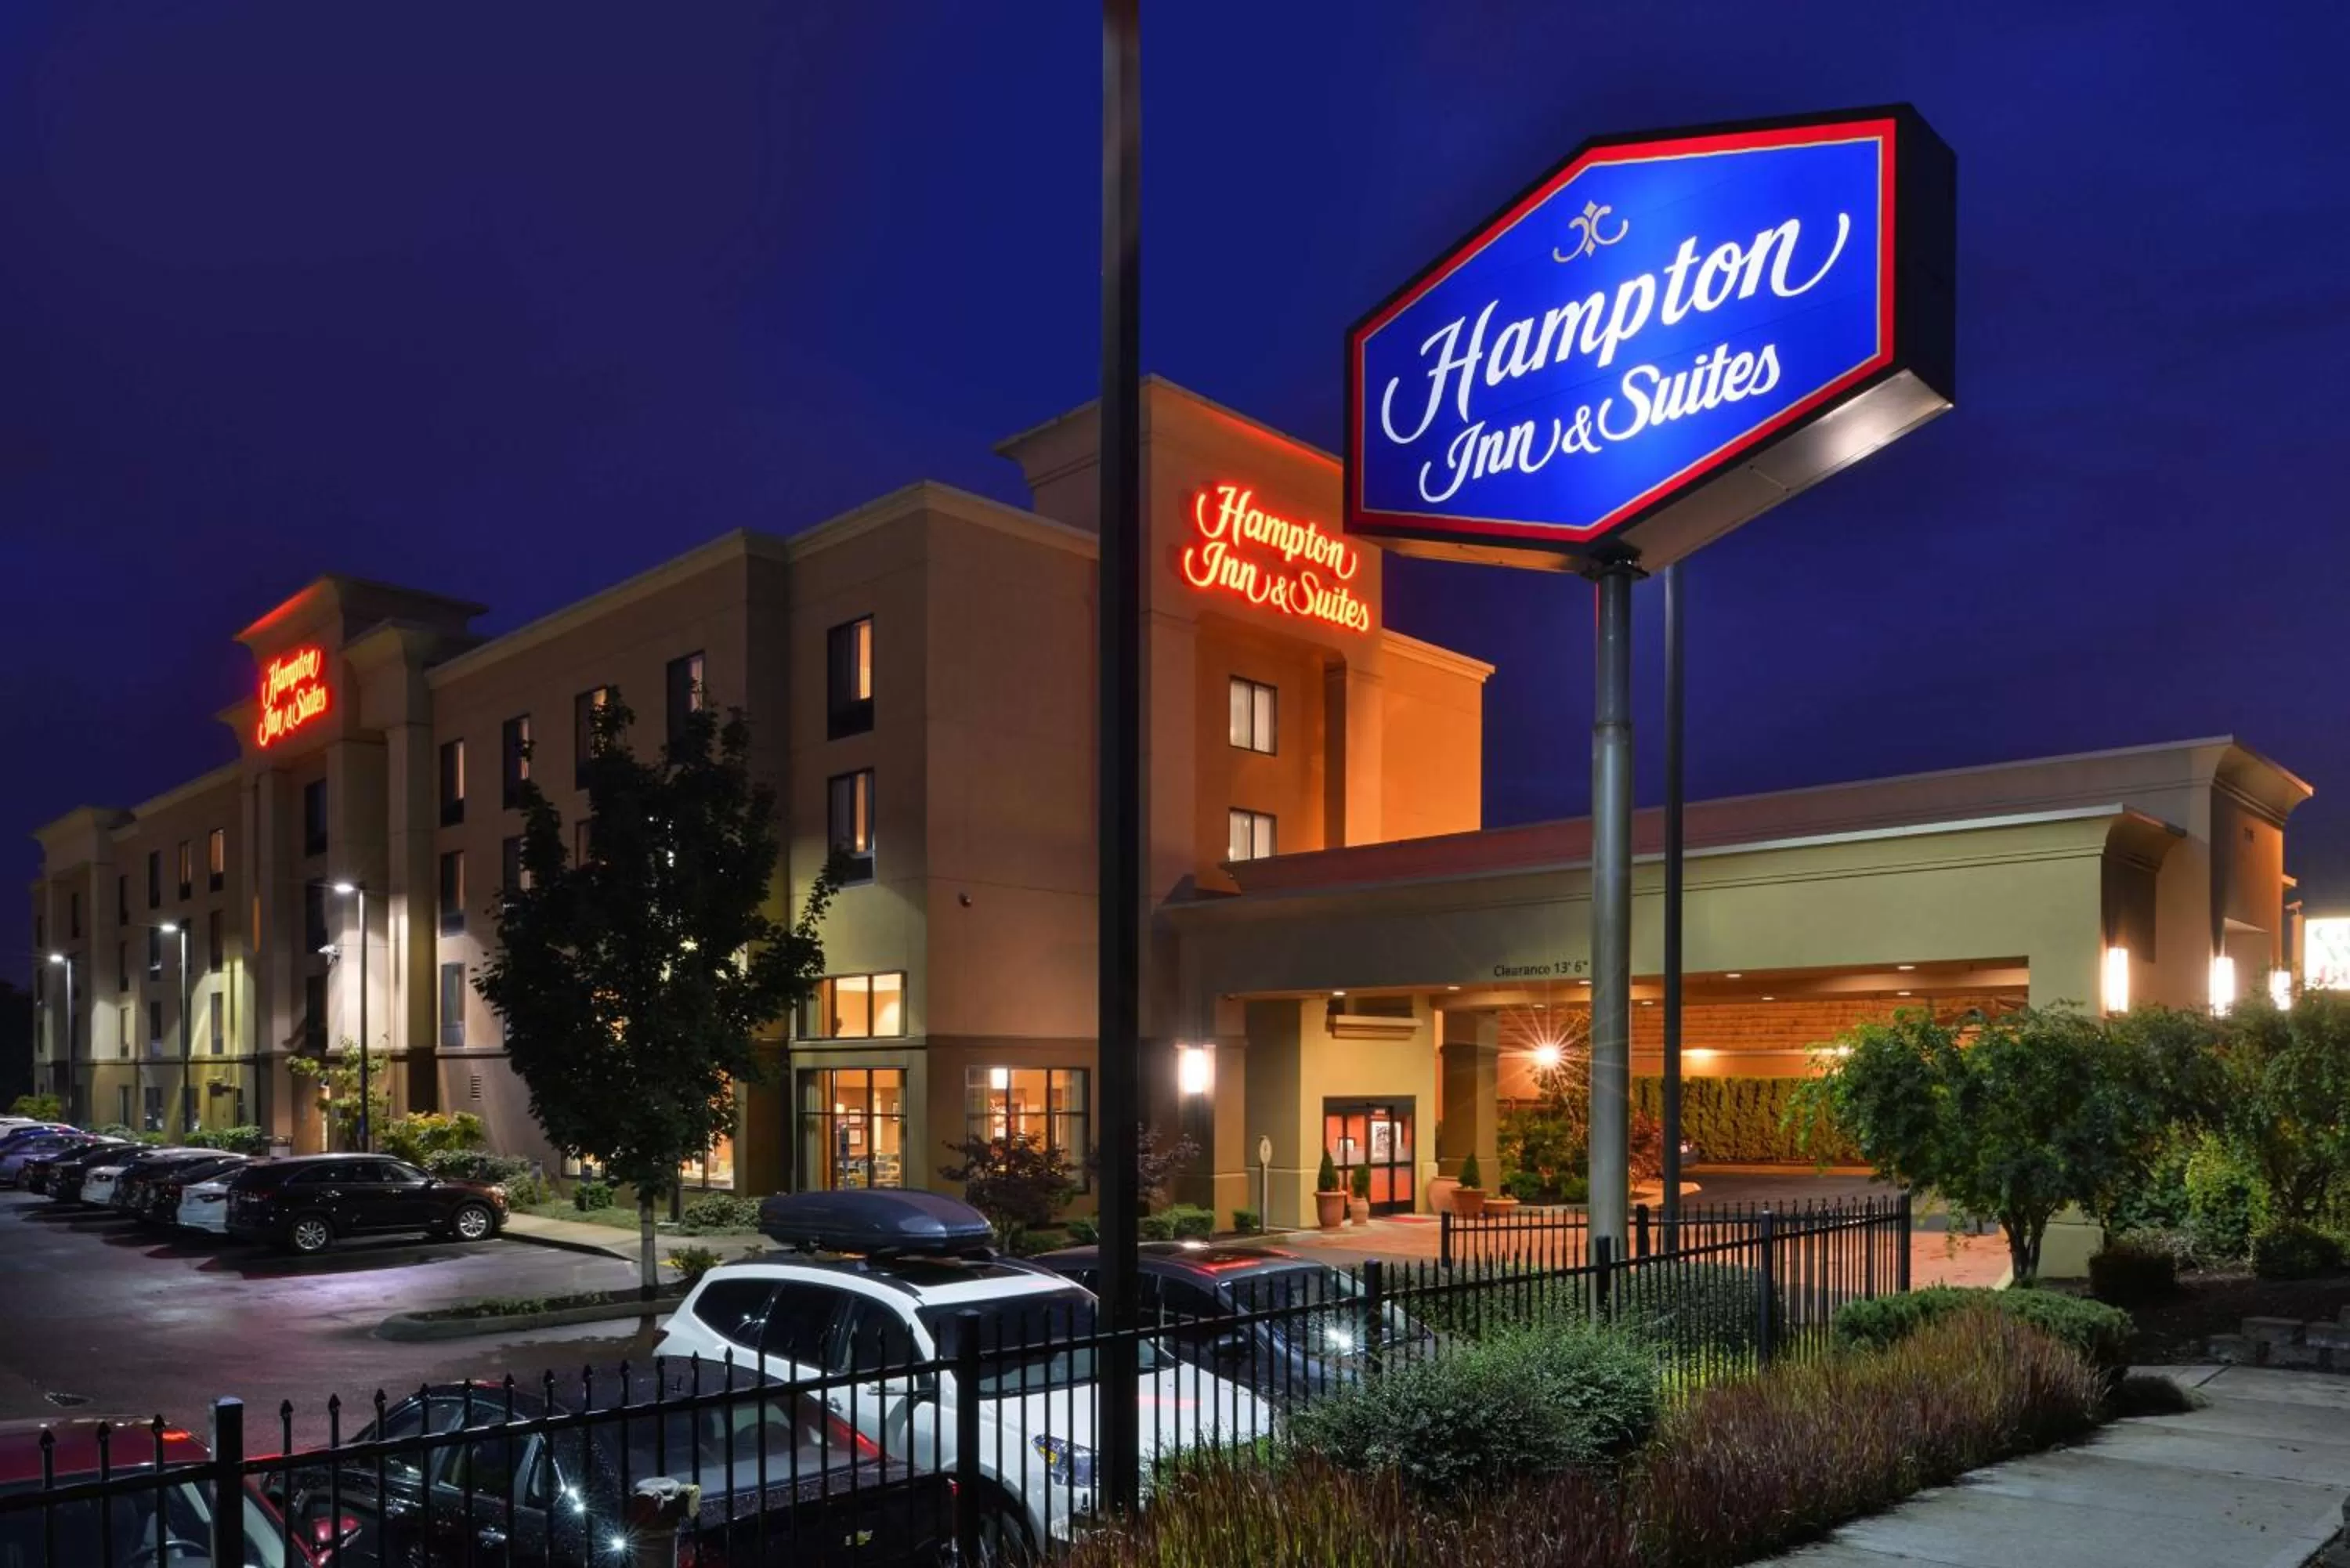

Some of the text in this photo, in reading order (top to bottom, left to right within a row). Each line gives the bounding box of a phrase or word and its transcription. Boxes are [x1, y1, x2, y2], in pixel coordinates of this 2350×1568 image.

[1380, 212, 1849, 444] Hampton
[1419, 344, 1781, 504] Inn & Suites
[1195, 485, 1358, 580] Hampton
[1184, 540, 1369, 632] Inn & Suites
[258, 706, 287, 746] Inn
[292, 682, 327, 725] Suites
[262, 649, 321, 709] Hampton
[1493, 963, 1551, 978] Clearance
[1553, 960, 1572, 974] 13'
